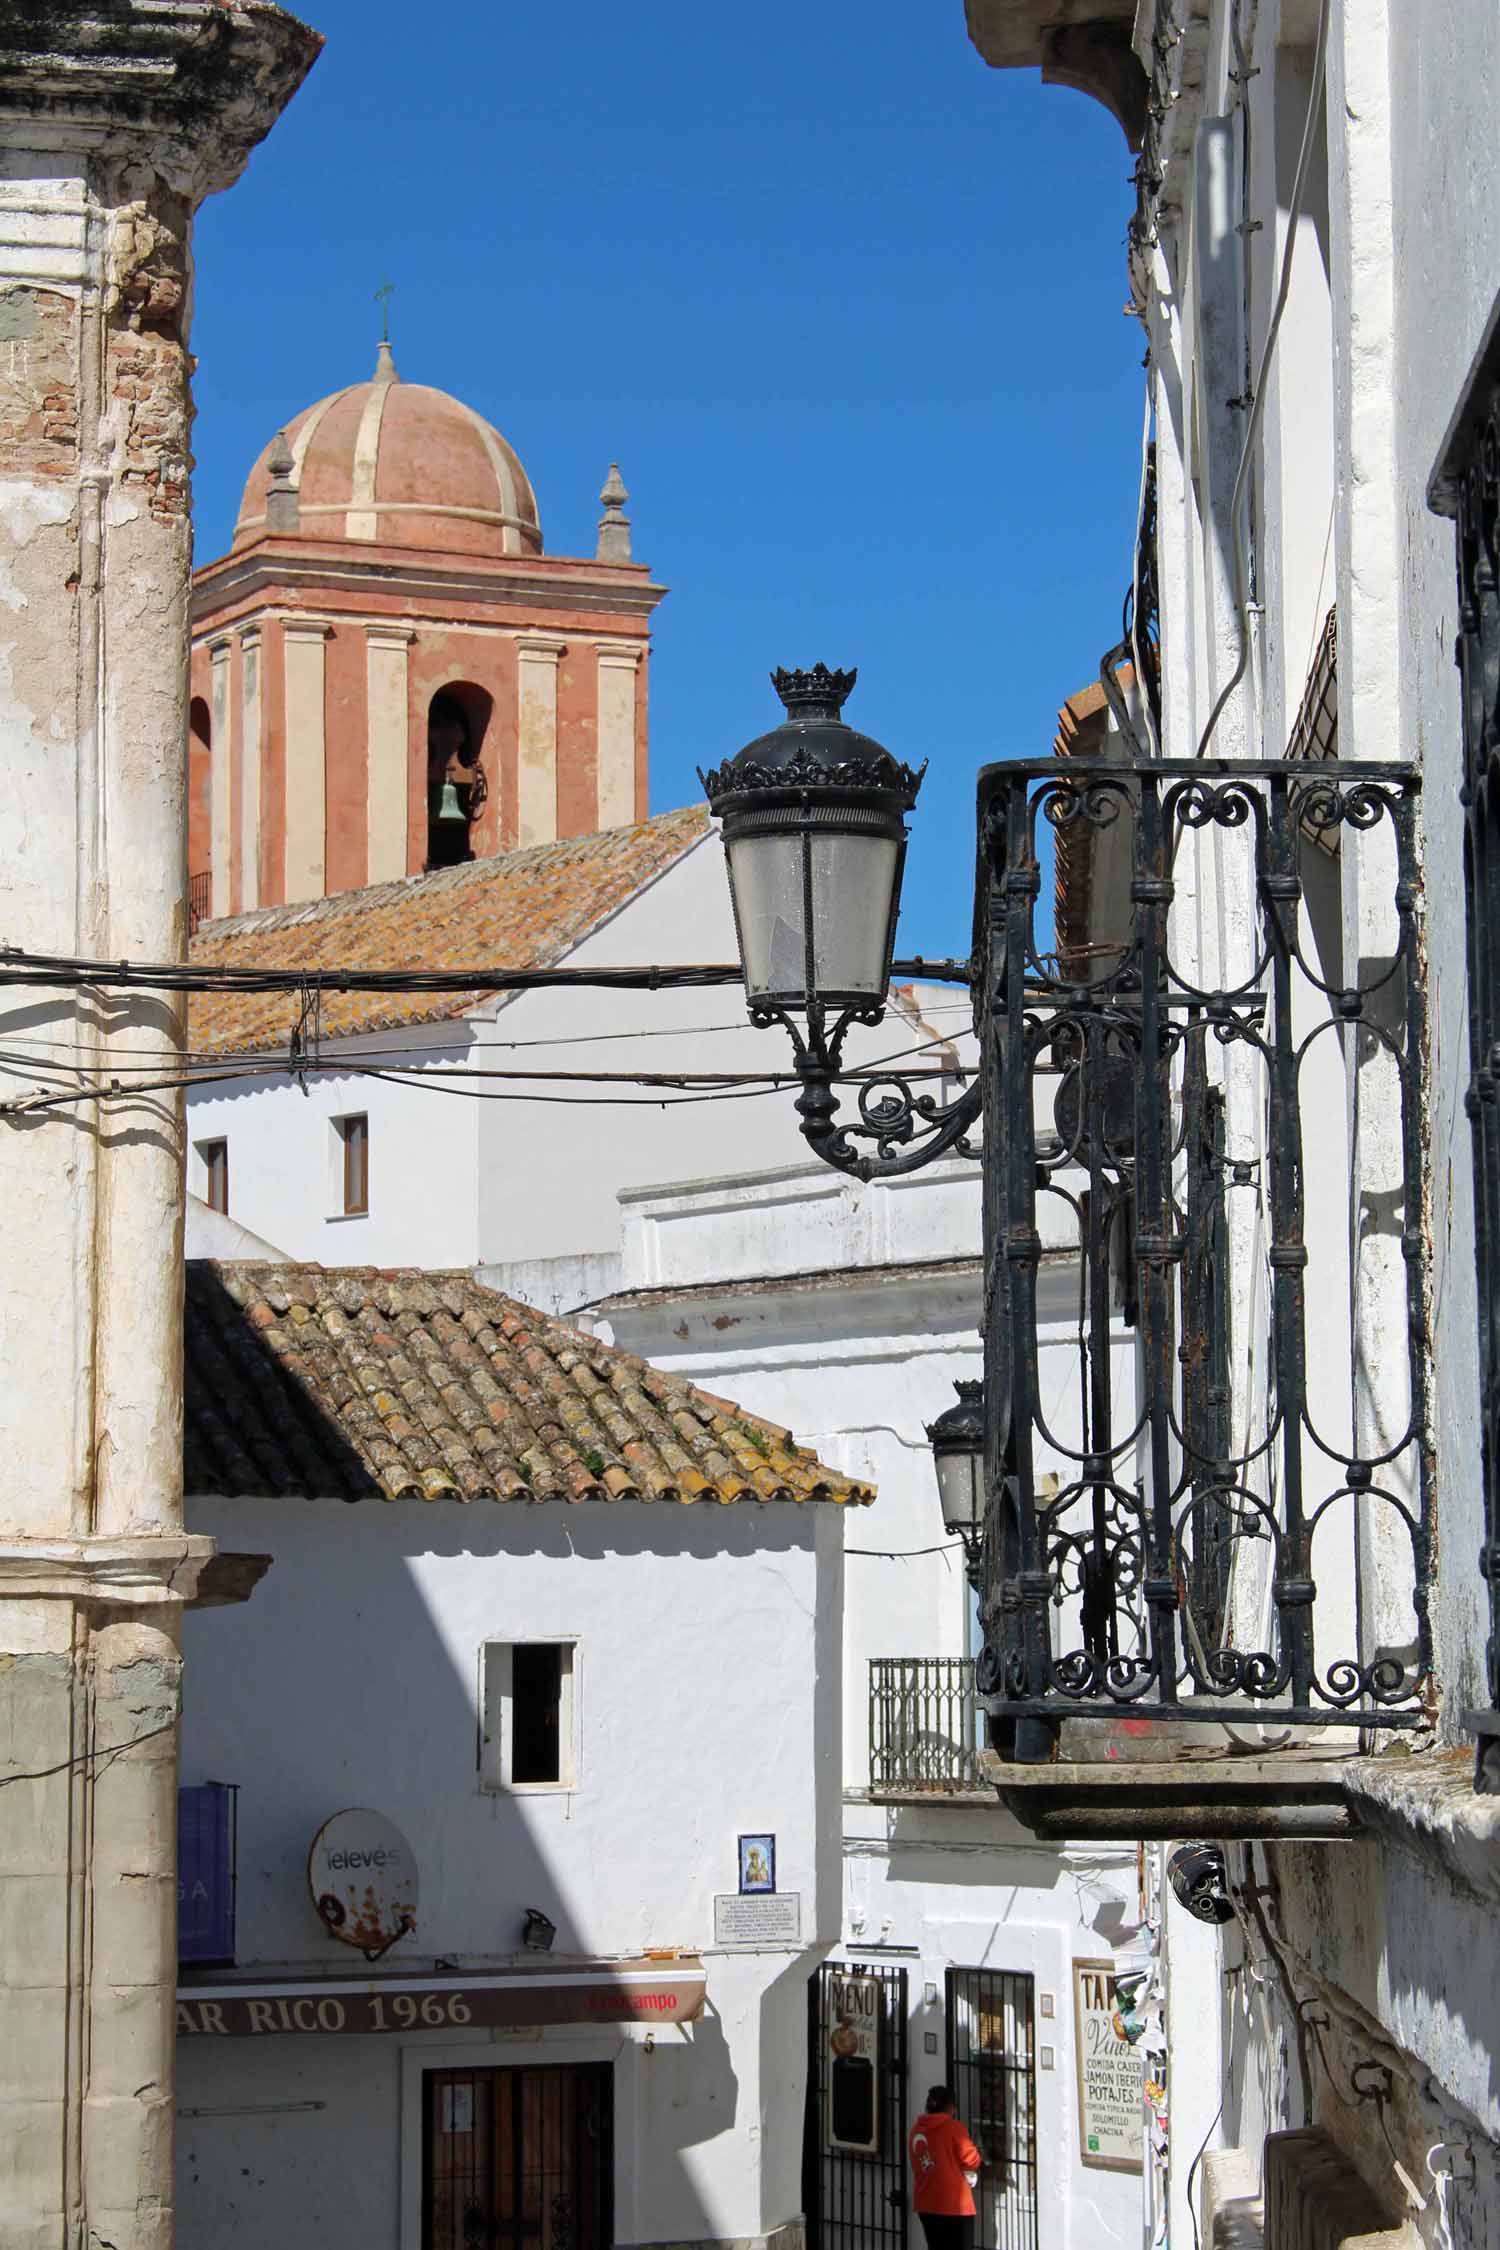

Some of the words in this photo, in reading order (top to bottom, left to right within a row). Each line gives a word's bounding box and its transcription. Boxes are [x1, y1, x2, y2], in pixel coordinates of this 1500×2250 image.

[586, 1992, 677, 2012] Ccampo
[247, 1999, 345, 2032] RICO
[368, 1993, 472, 2030] 1966
[643, 2033, 655, 2054] 5
[1086, 2058, 1115, 2071] COMIDA
[1088, 2085, 1134, 2104] POTAJES
